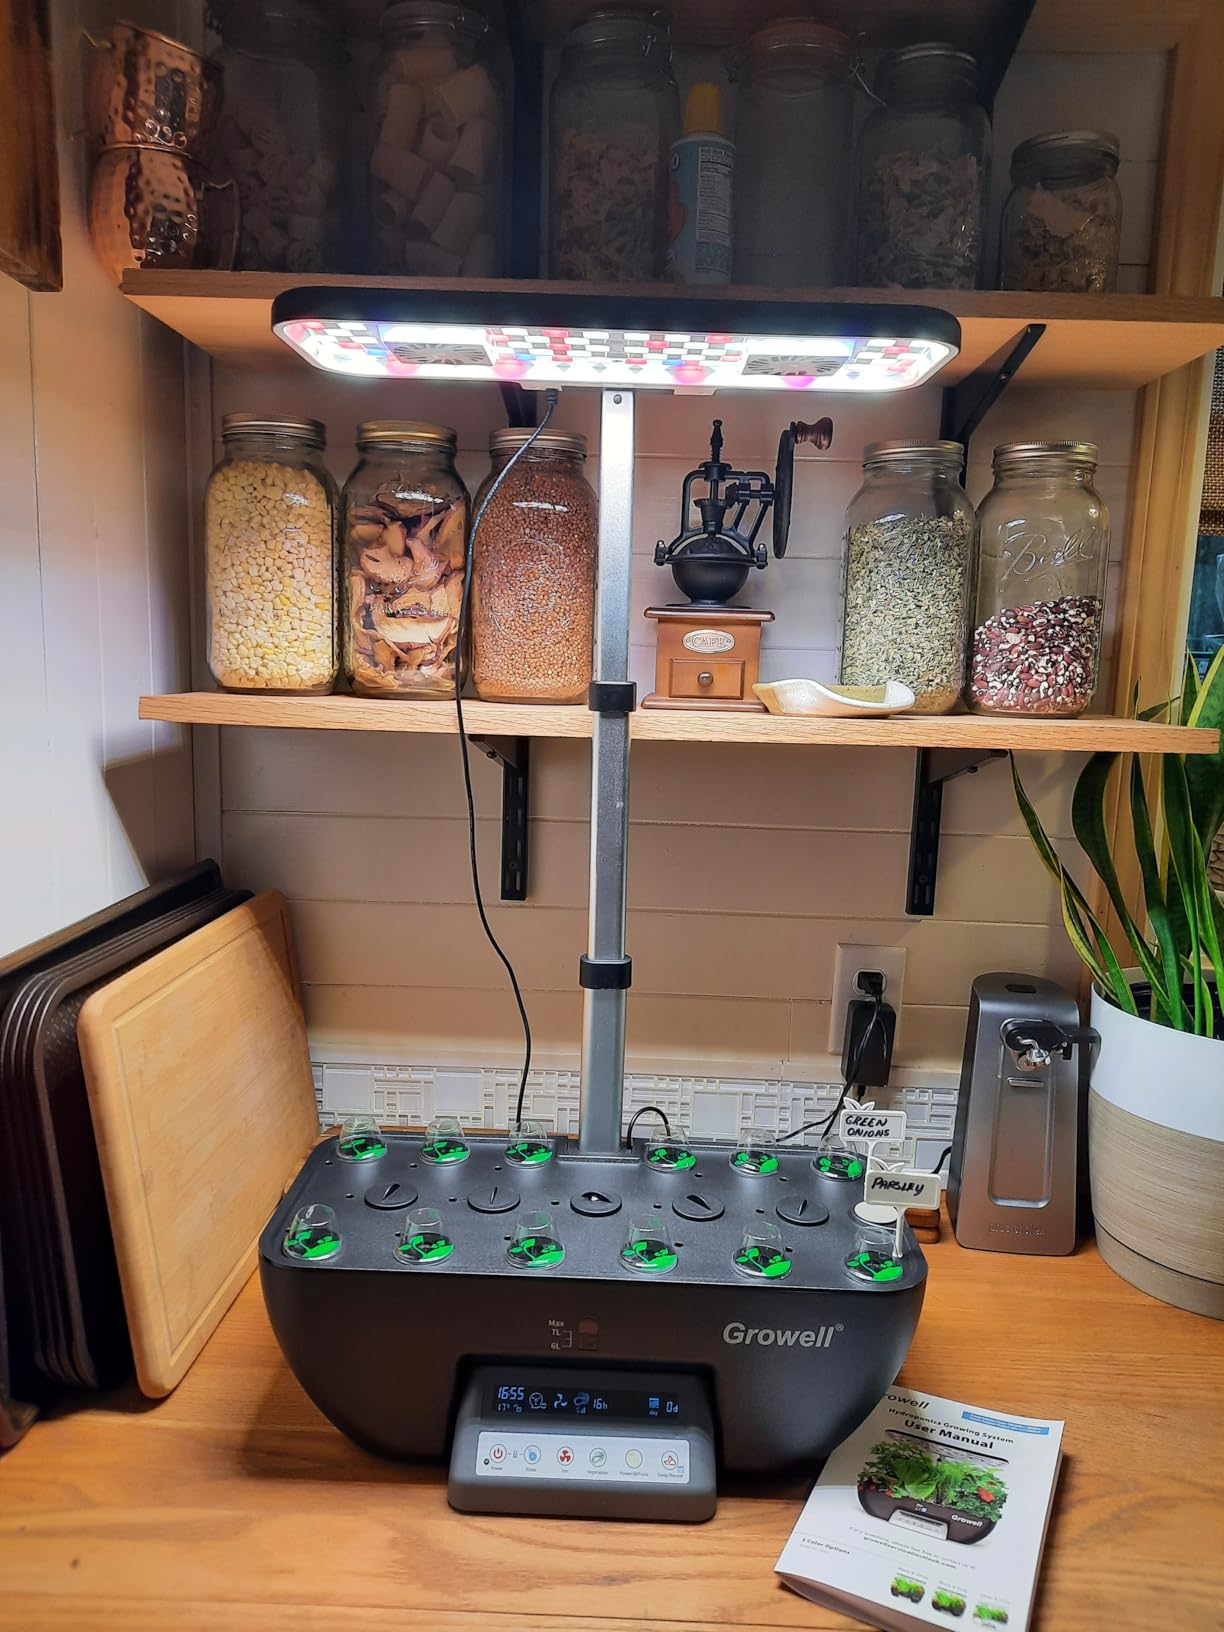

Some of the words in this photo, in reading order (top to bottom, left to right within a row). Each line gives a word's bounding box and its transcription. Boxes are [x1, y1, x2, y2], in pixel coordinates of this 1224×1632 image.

[845, 1115, 888, 1127] GREEN
[847, 1128, 890, 1137] ONIONS
[871, 1177, 924, 1196] PARSLEY
[548, 1319, 564, 1327] Max
[551, 1328, 561, 1336] 7L
[550, 1342, 561, 1350] 6L
[498, 1386, 525, 1400] 16:55
[593, 1398, 608, 1410] 16h
[666, 1401, 679, 1413] 0d
[887, 1394, 930, 1409] owell
[889, 1408, 941, 1426] Hydroponics
[944, 1422, 980, 1437] Growing
[983, 1433, 1014, 1443] System
[904, 1420, 937, 1434] User
[939, 1429, 994, 1449] Manual
[951, 1514, 983, 1527] Growell
[825, 1544, 850, 1555] Options
